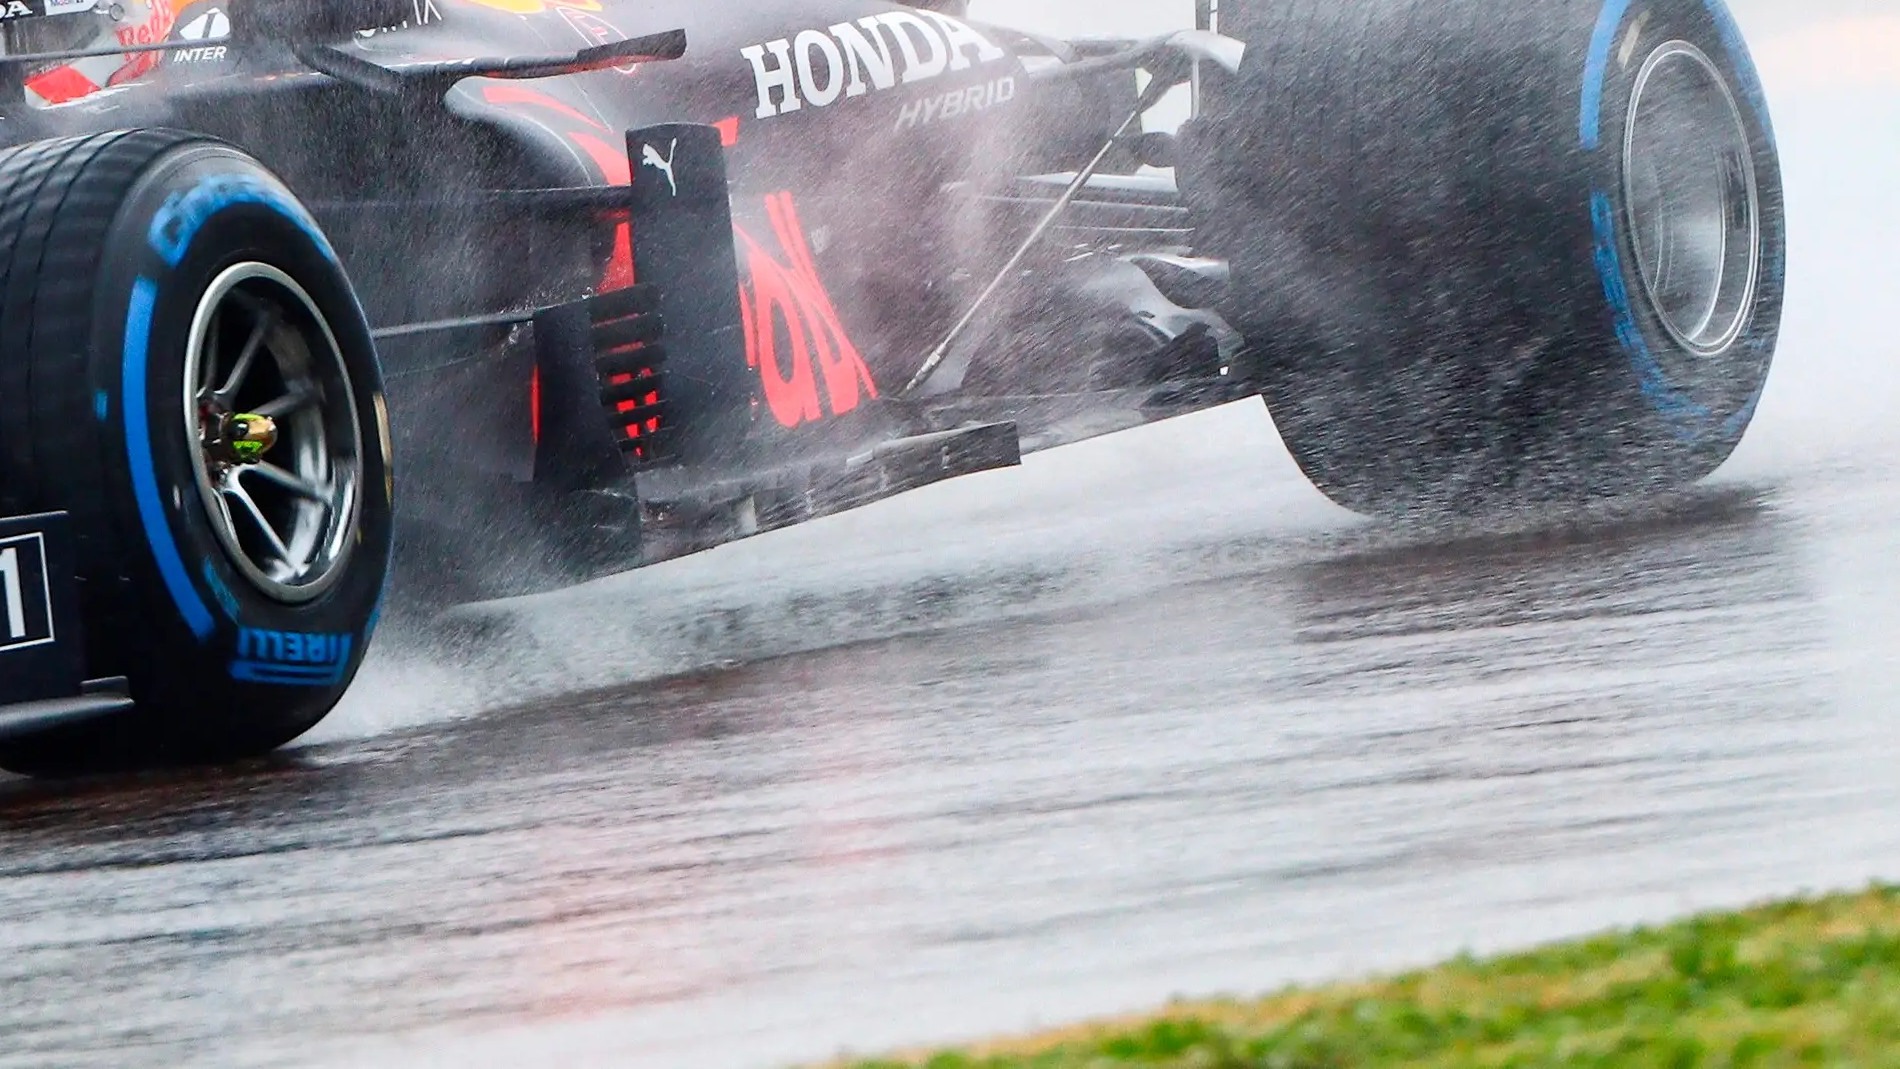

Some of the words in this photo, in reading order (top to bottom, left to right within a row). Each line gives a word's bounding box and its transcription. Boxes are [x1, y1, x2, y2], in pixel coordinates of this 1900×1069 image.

[174, 46, 227, 62] INTER
[740, 9, 1005, 119] HONDA
[894, 76, 1015, 130] HYBRID
[228, 624, 353, 686] PIRELLI
